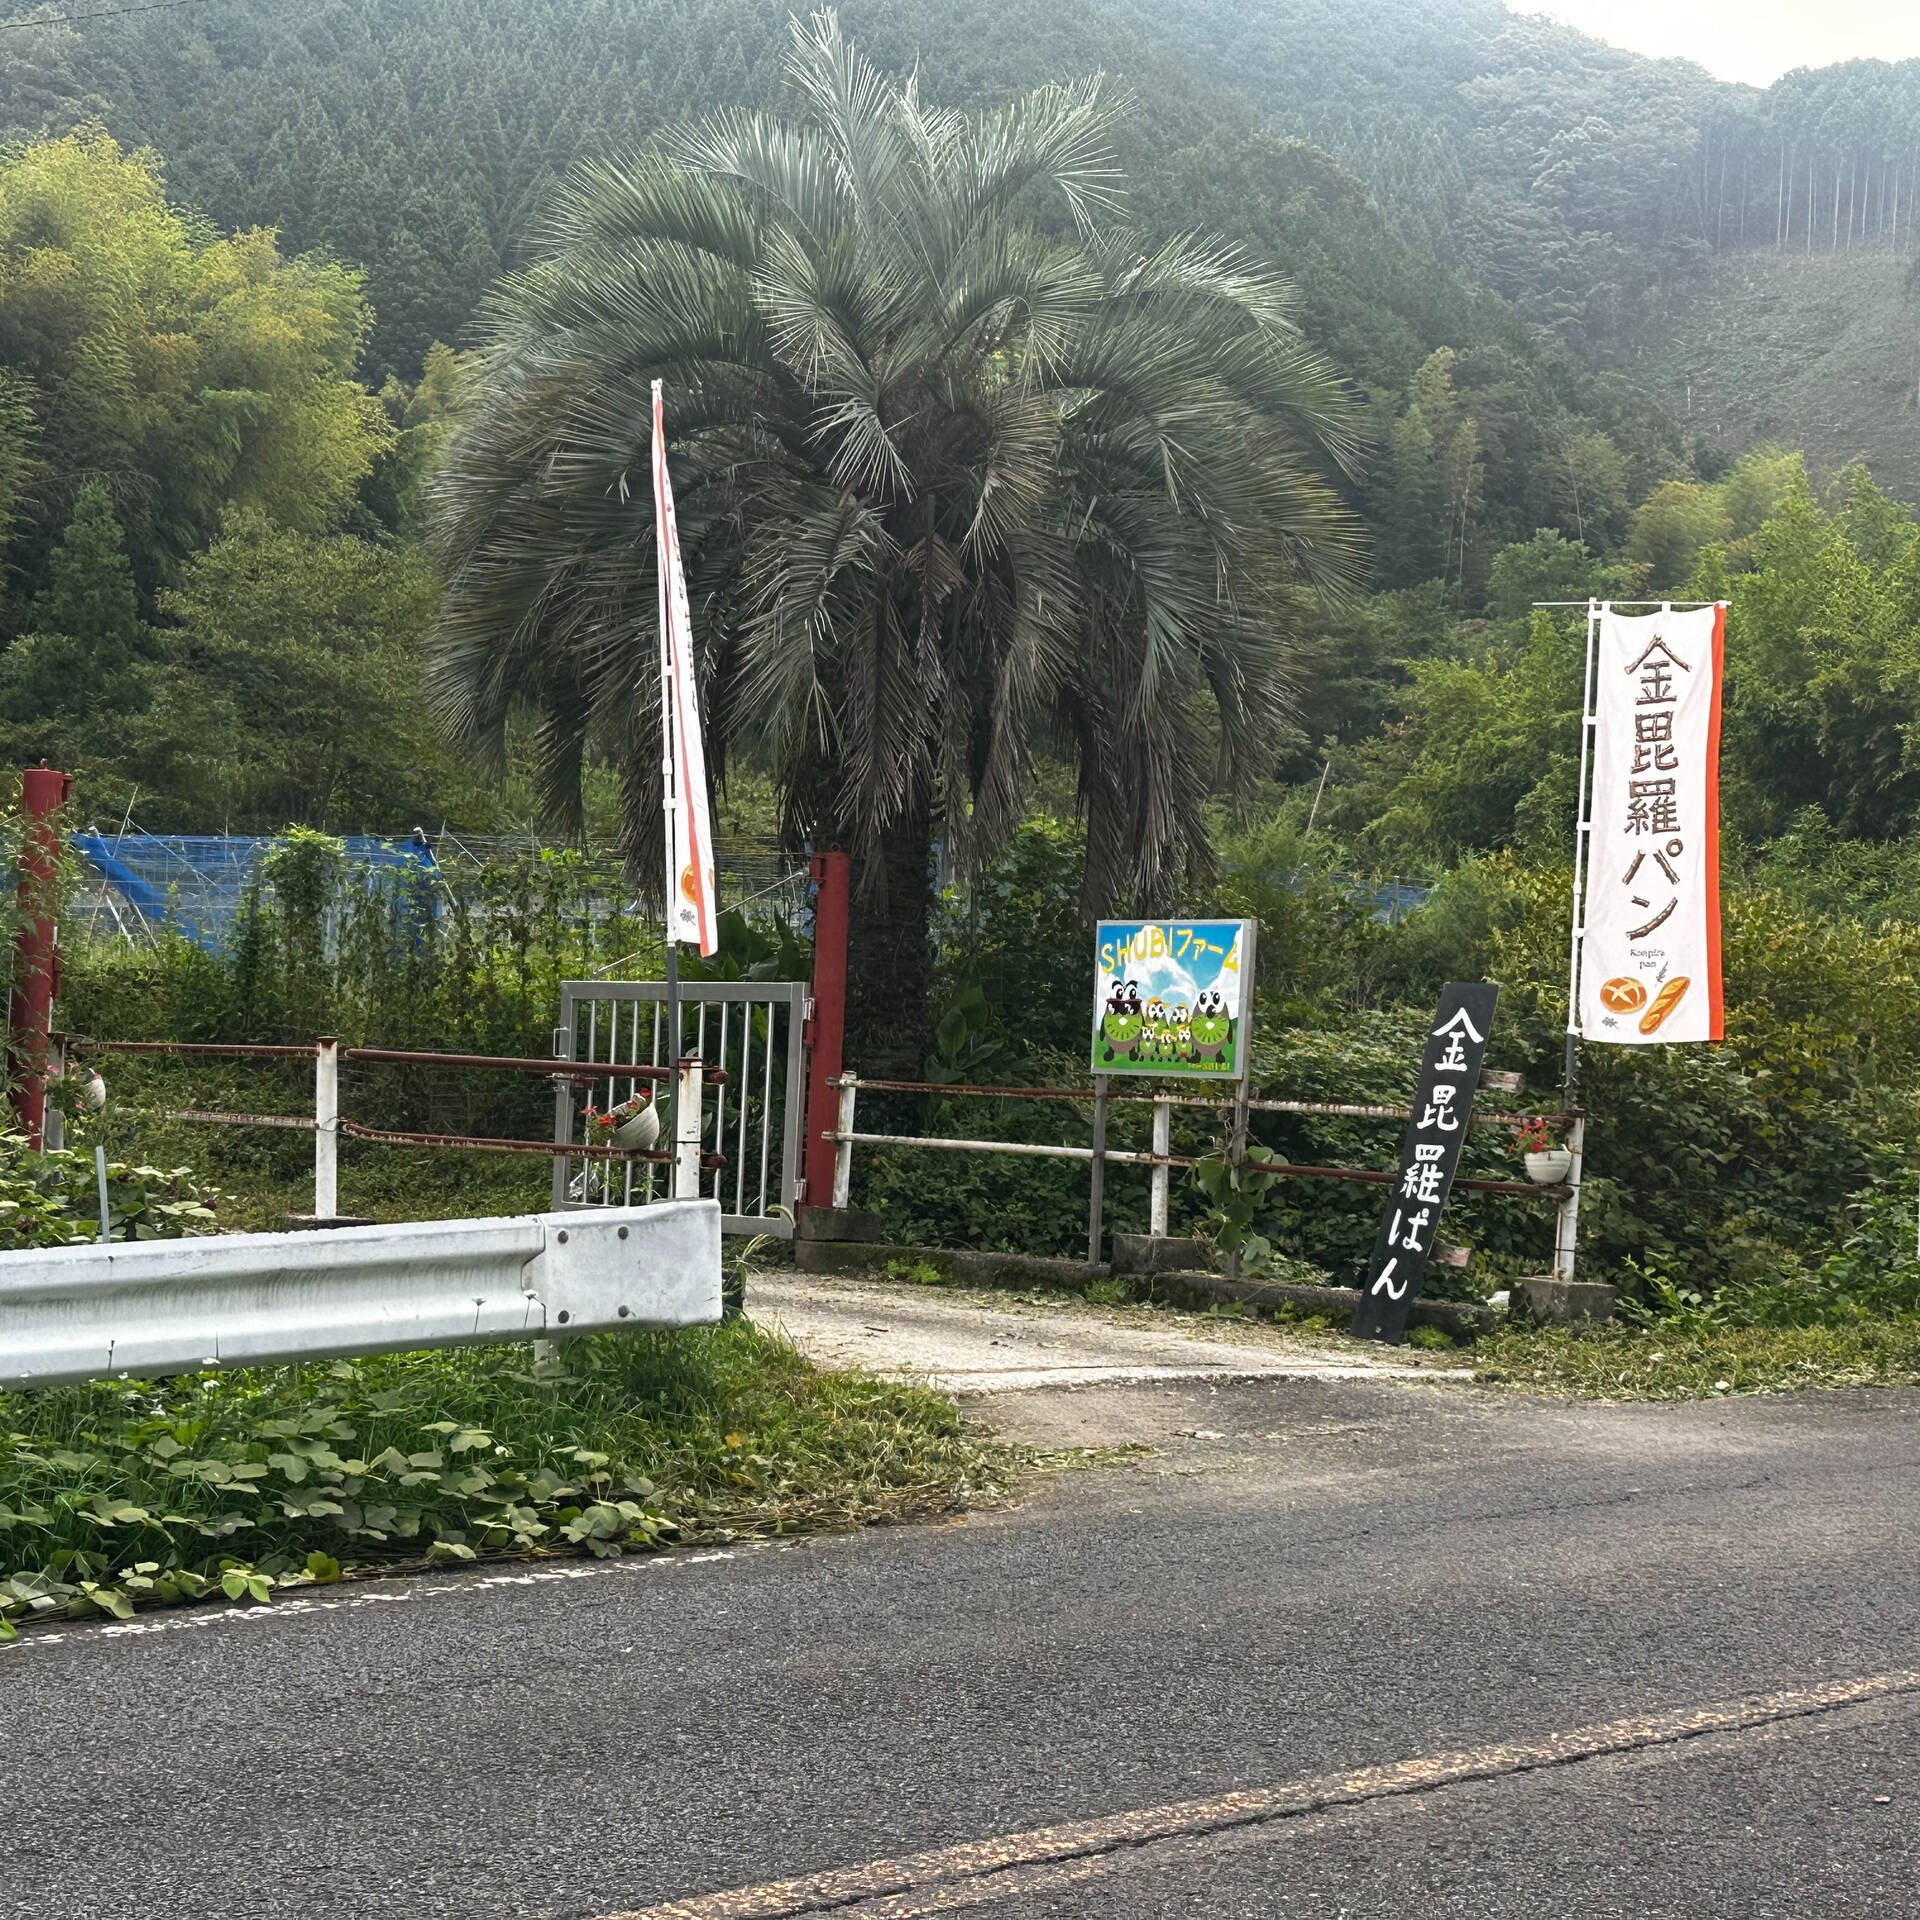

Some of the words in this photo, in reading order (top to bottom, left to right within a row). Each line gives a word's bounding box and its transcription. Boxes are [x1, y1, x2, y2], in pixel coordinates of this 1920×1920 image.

[1622, 633, 1692, 941] 金毘羅パン
